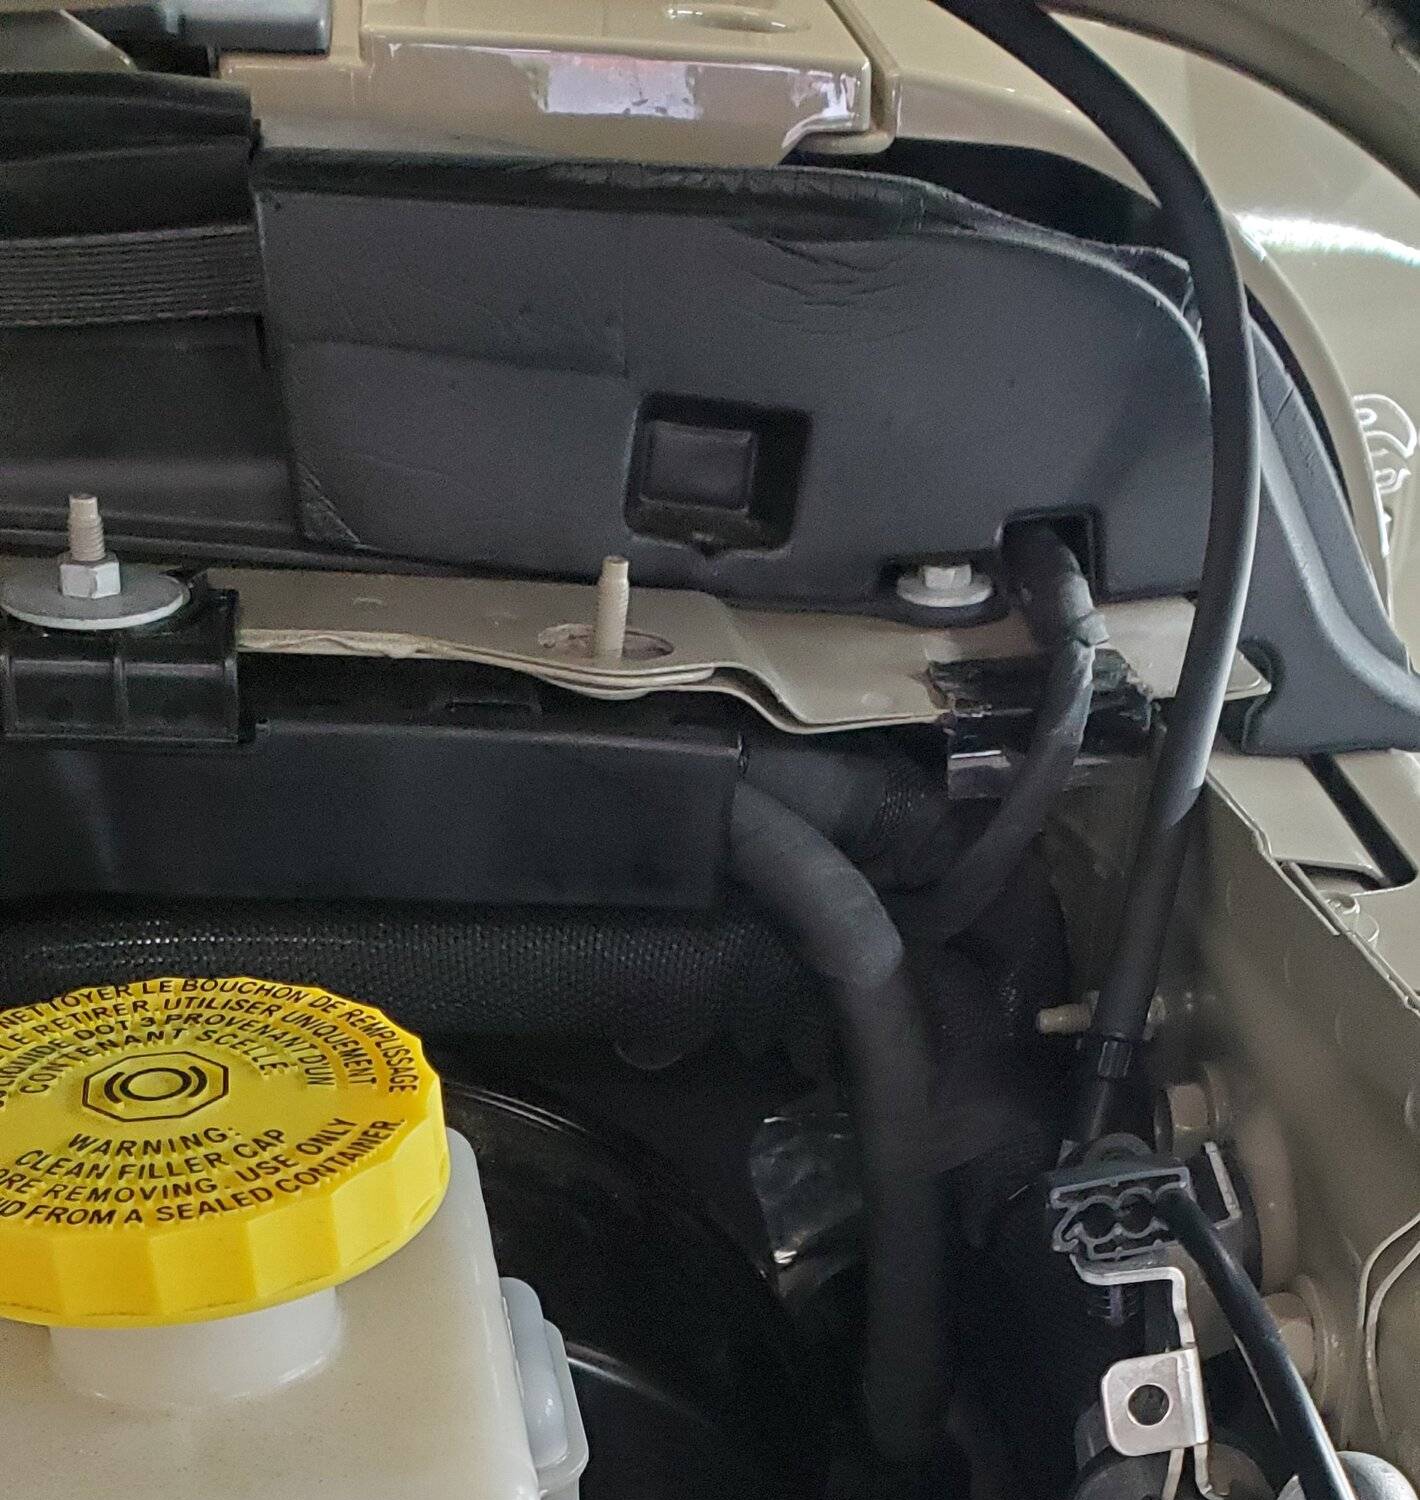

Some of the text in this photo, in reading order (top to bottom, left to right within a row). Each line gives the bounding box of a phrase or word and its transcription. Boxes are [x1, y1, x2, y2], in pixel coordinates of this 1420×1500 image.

[0, 979, 419, 1093] NETTOYER LE BOUCHON DE REMPLISSAGE
[19, 1027, 290, 1094] CONTENANT SCELLE
[32, 1000, 150, 1037] RETIRER
[163, 996, 283, 1018] UTILISER
[280, 1010, 378, 1085] UNIQUEMENT
[73, 1020, 129, 1041] DOT
[139, 1016, 157, 1027] 3
[164, 1013, 319, 1053] PROVENANT
[297, 1054, 337, 1086] D'UN
[15, 1128, 287, 1181] CLEAN FILLER CAP
[67, 1127, 242, 1157] WARNING:
[234, 1153, 301, 1183] USE
[295, 1117, 359, 1156] ONLY
[23, 1204, 118, 1225] FROM
[123, 1208, 144, 1225] A
[155, 1186, 274, 1223] SEALED
